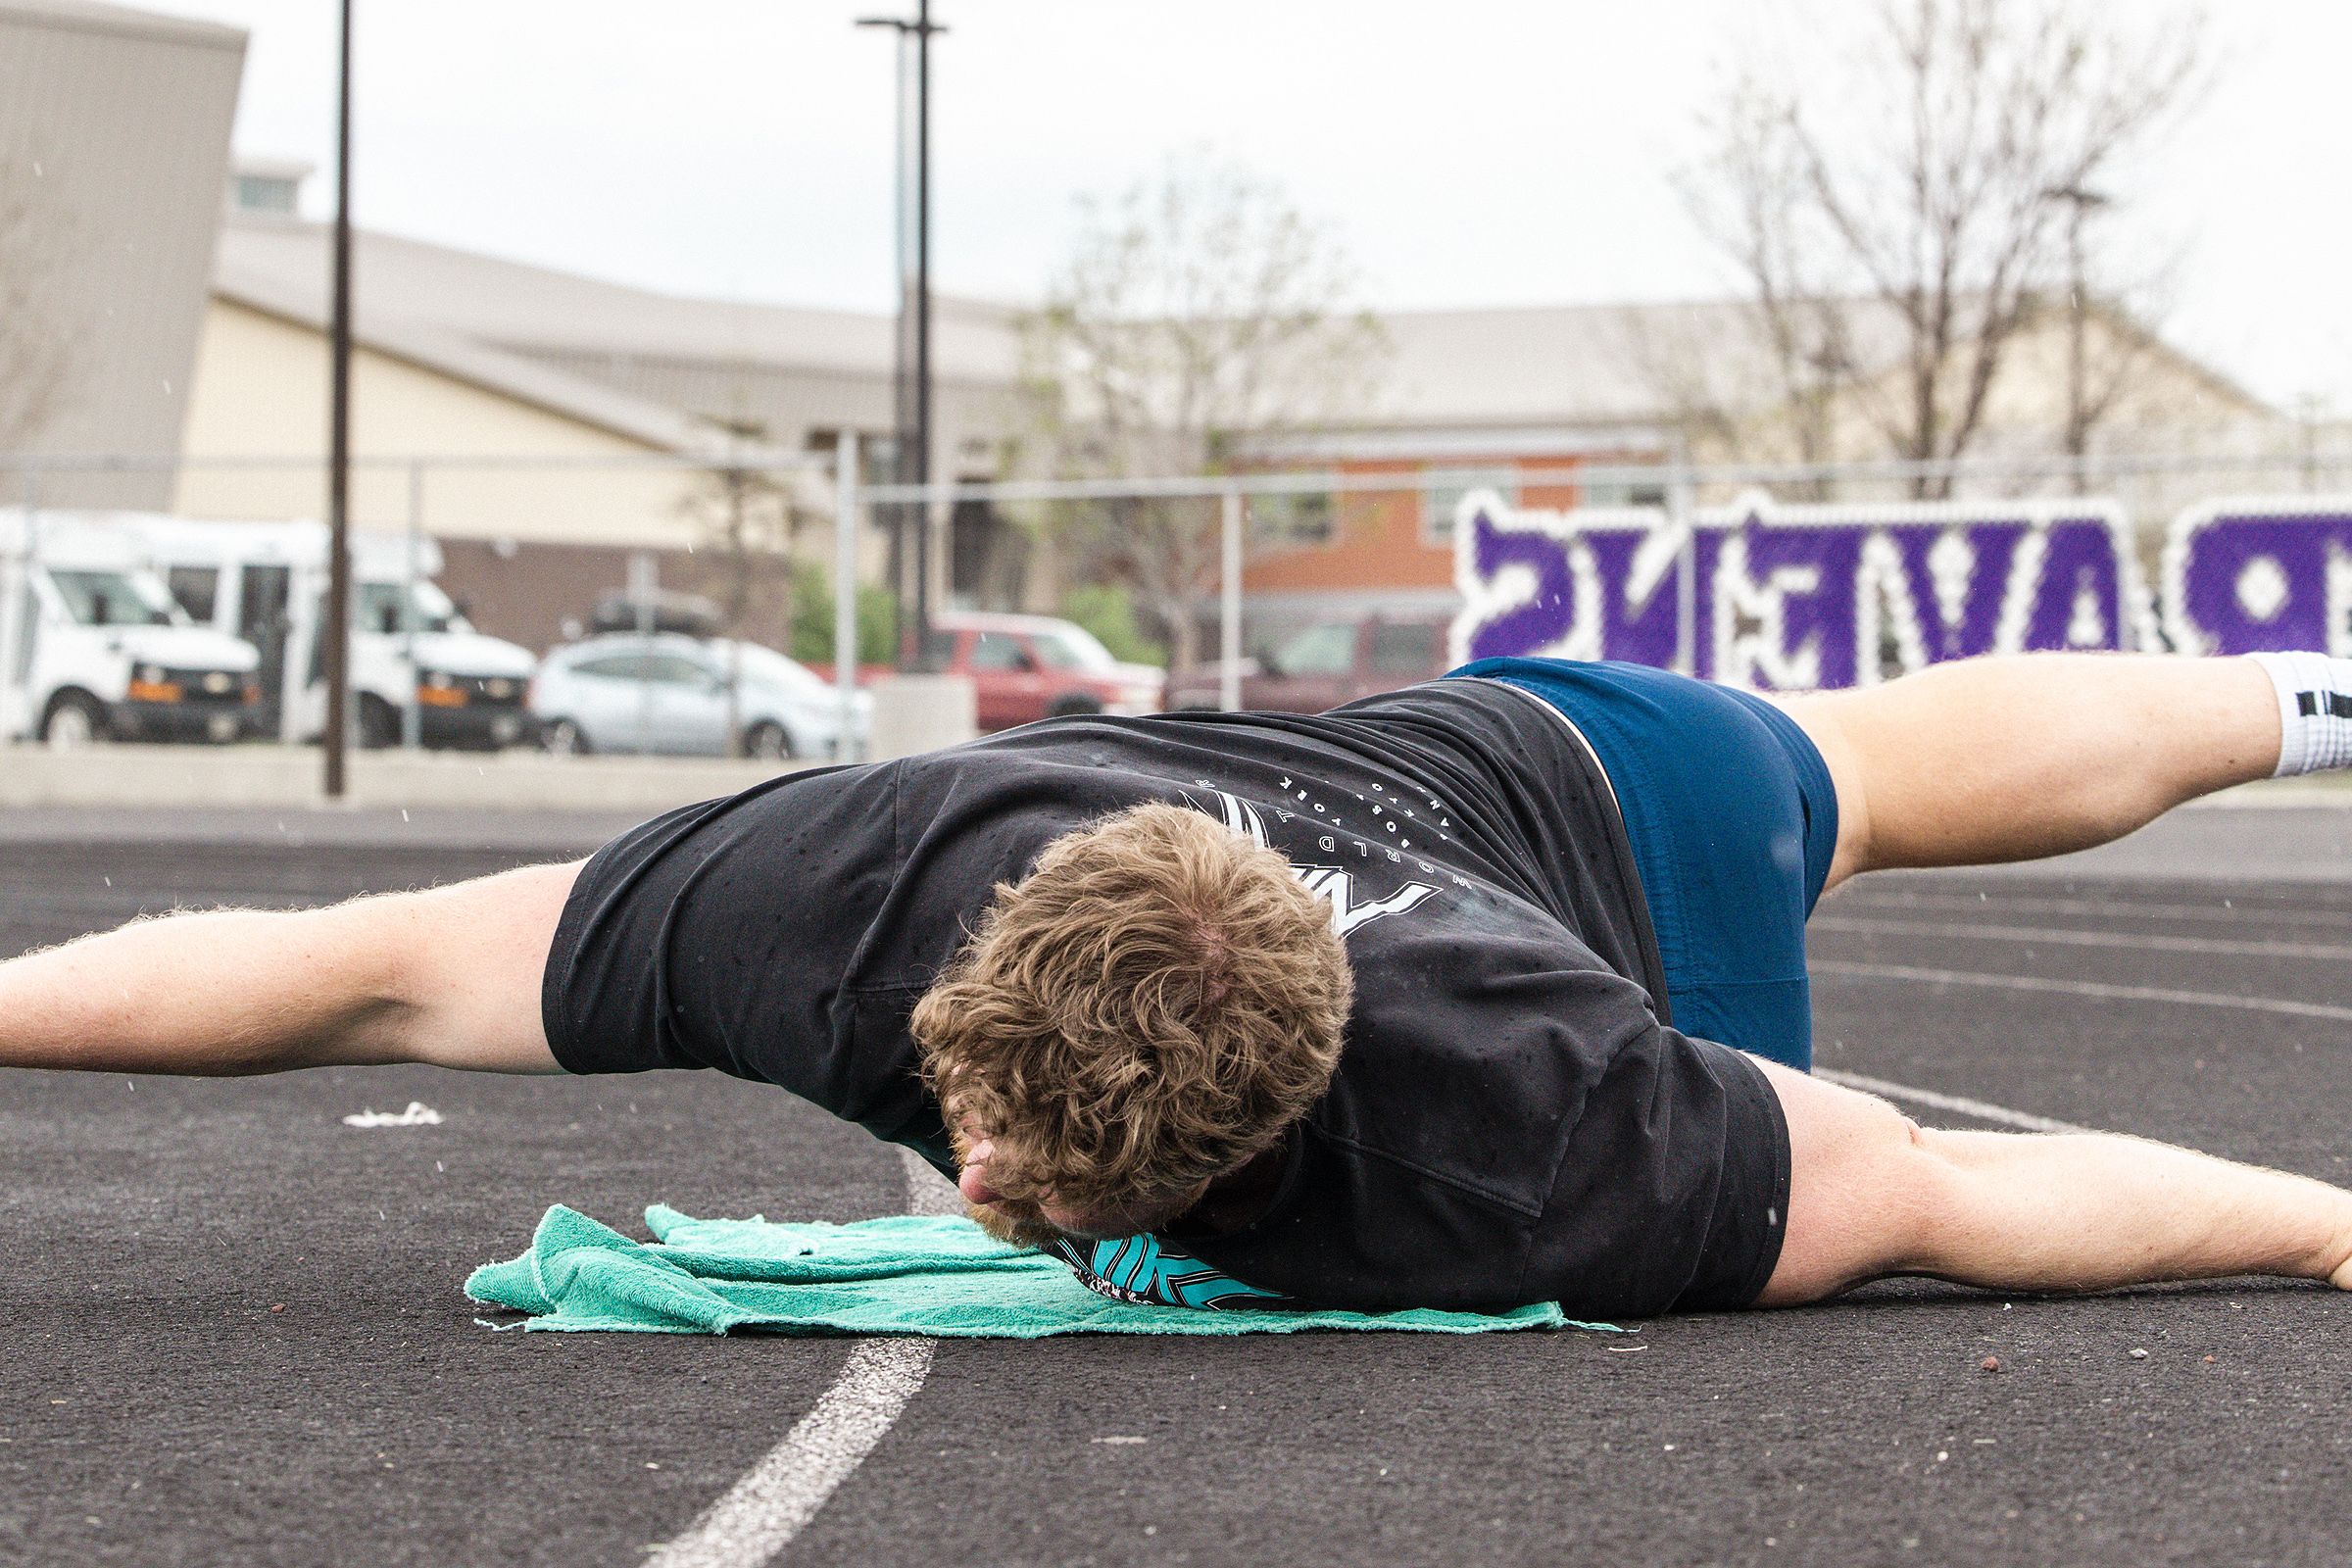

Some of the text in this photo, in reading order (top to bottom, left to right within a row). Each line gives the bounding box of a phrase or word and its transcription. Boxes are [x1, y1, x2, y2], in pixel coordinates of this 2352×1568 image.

[1279, 775, 1342, 827] YORK
[1348, 791, 1411, 849] BOST
[1318, 835, 1473, 890] WORLD
